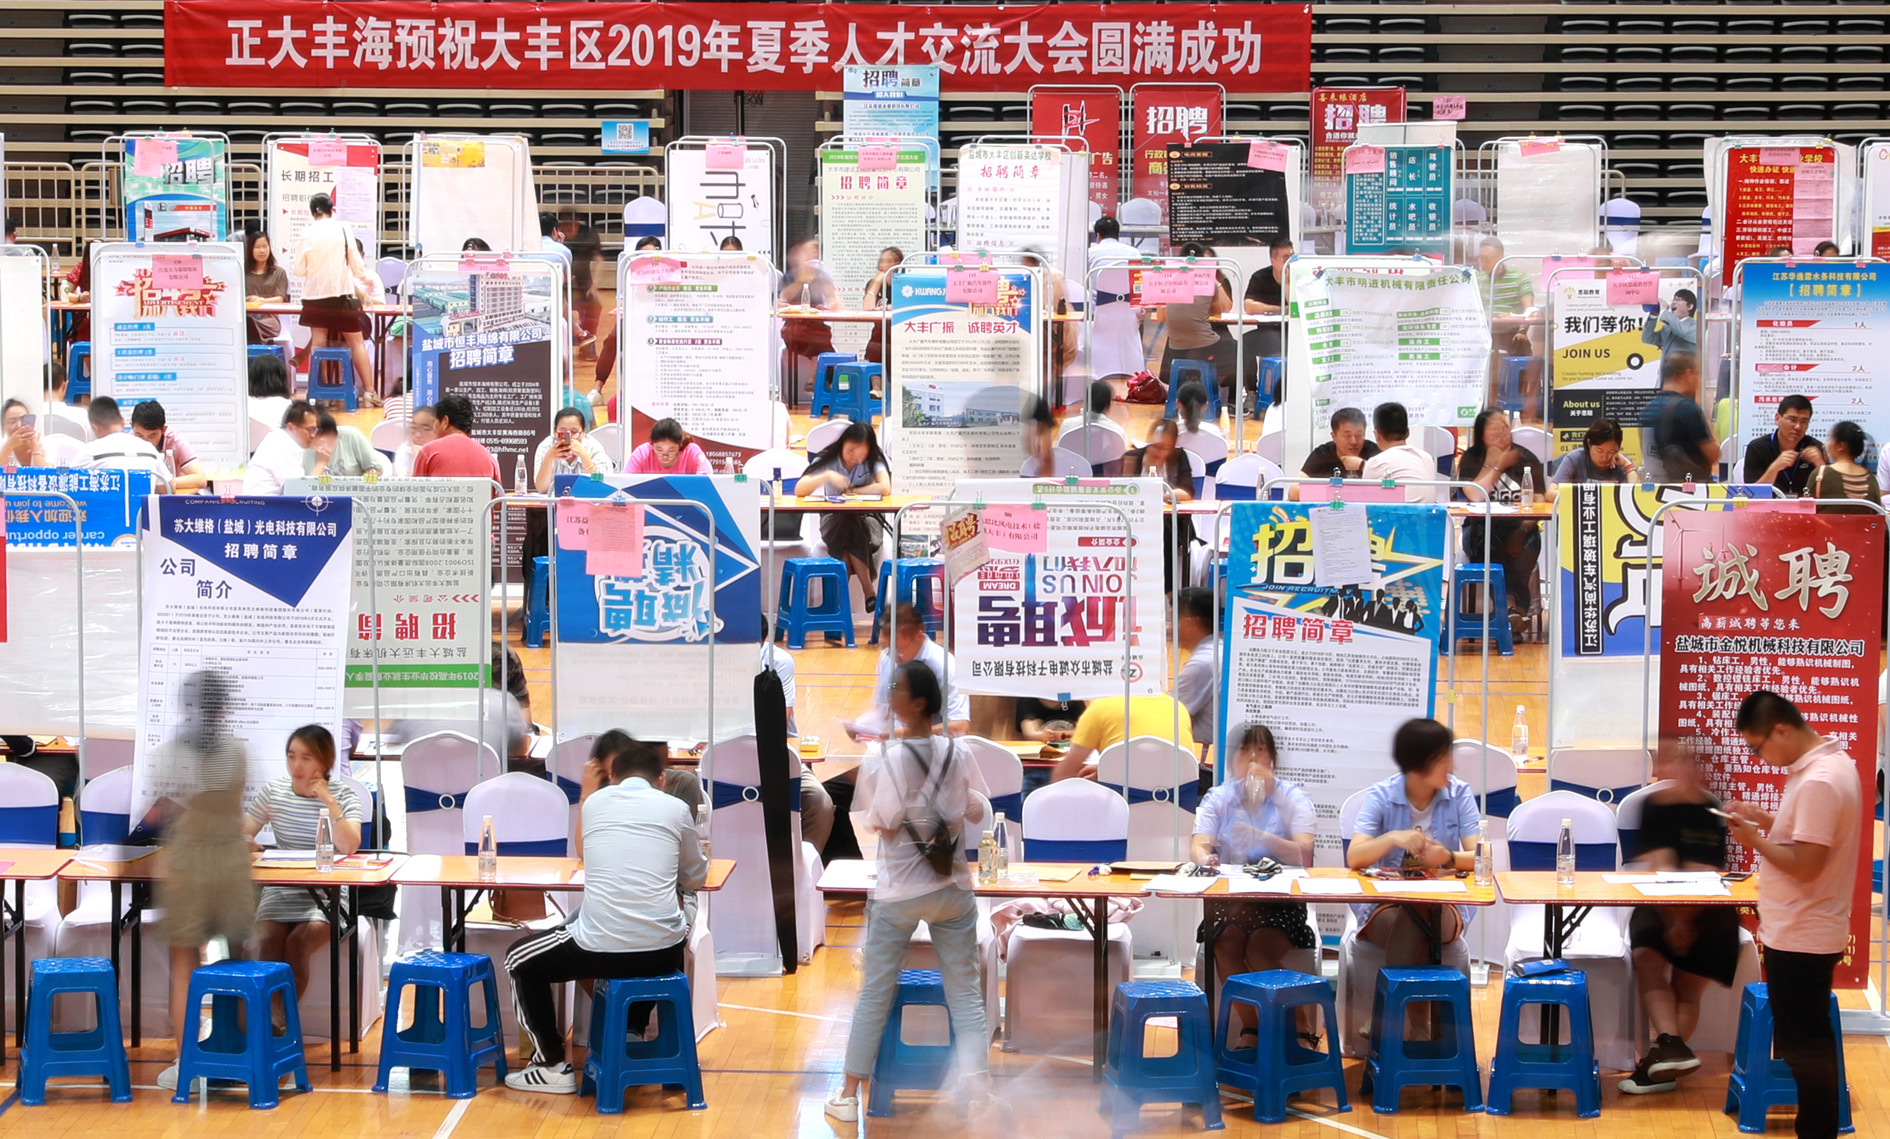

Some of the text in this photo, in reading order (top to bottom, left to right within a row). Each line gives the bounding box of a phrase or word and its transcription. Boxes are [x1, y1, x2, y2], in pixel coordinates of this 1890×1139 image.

[226, 16, 1262, 75] 正大丰海预祝大丰区2019年夏季人才交流大会圆满成功
[863, 70, 898, 87] 招聘
[1146, 106, 1208, 140] 招聘
[1324, 104, 1387, 131] 招聘
[1739, 154, 1760, 164] 大丰
[281, 170, 335, 183] 长期招工
[980, 164, 1041, 179] 招聘简章
[840, 176, 909, 190] 招聘简章
[1326, 274, 1471, 291] 大丰市明进机械有限责任公司
[904, 321, 1019, 334] 大丰广振 诚聘英才
[1564, 316, 1644, 334] 我们等你!
[422, 328, 543, 352] 盐城市恒丰海绵有限公司
[450, 346, 514, 368] 招聘简章
[1562, 348, 1610, 358] JOIN US
[1563, 400, 1588, 408] About
[13, 499, 30, 508] join
[44, 500, 88, 508] wecome
[174, 518, 337, 537] 苏大维格（盐城）光电科技有限公司
[1091, 538, 1121, 546] 企业简介
[224, 543, 298, 560] 招聘简章
[160, 558, 196, 576] 公司
[1043, 556, 1138, 572] 加入我们
[196, 580, 233, 599] 简介
[356, 580, 460, 588] 盐城大丰远大机床有限公司专业
[983, 582, 1016, 590] DREAM
[1043, 574, 1075, 594] US
[977, 553, 1143, 648] 诚聘
[358, 612, 457, 640] 招聘简
[1242, 614, 1354, 643] 招聘简章
[1701, 616, 1800, 631] 高薪诚聘等您来
[350, 647, 468, 658] 盐城大丰远大机床有
[1675, 635, 1865, 656] 盐城市金悦机械科技有限公司
[972, 660, 1113, 678] 盐城市众诚电子科技有限公司
